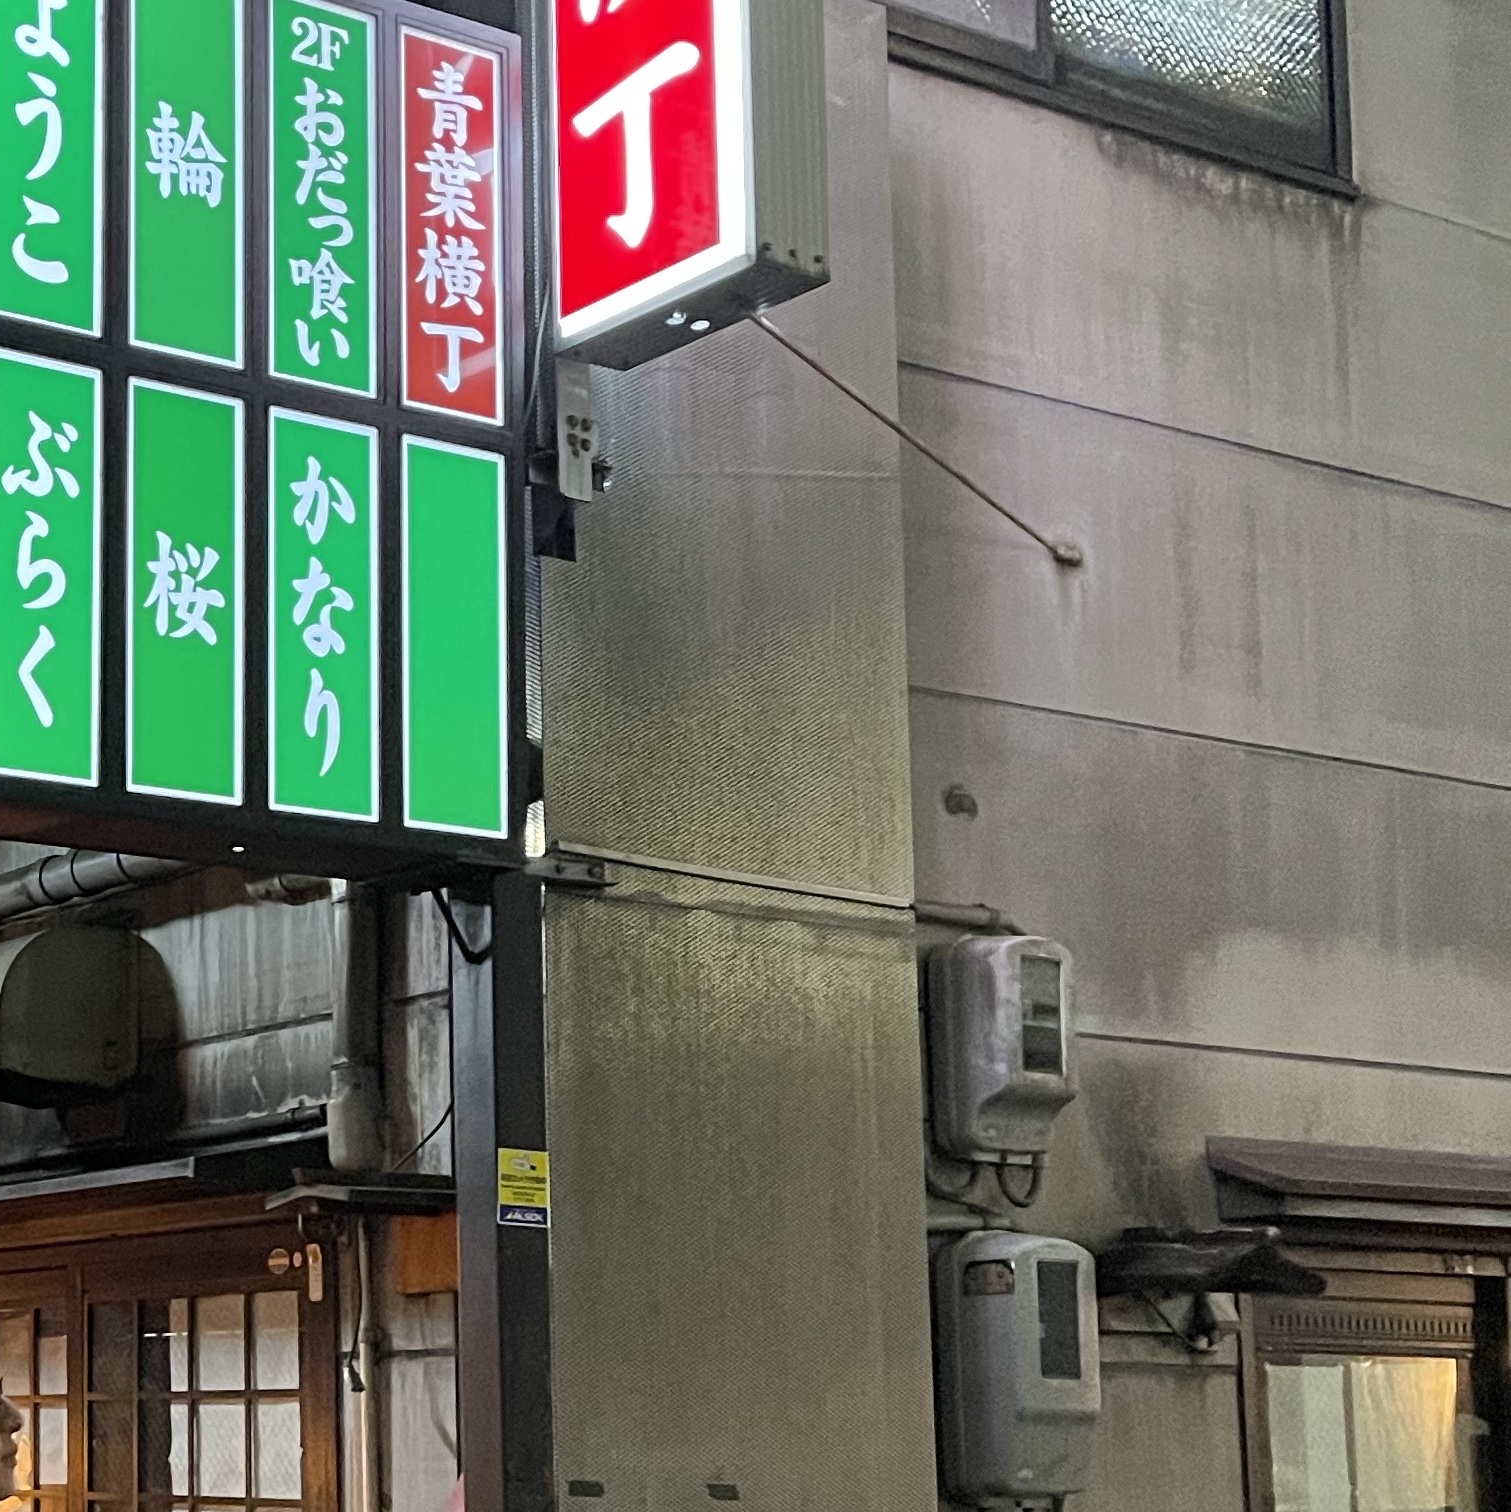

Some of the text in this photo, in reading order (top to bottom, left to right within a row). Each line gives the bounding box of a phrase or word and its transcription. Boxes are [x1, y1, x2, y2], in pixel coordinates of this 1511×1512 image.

[13, 0, 69, 283] ようこ
[146, 101, 227, 207] 輪
[291, 16, 349, 71] 2F
[572, 0, 700, 248] 丁
[414, 61, 484, 392] 青葉横丁
[2, 411, 79, 727] ぶらく
[144, 531, 225, 645] 桜
[291, 457, 355, 776] かなり
